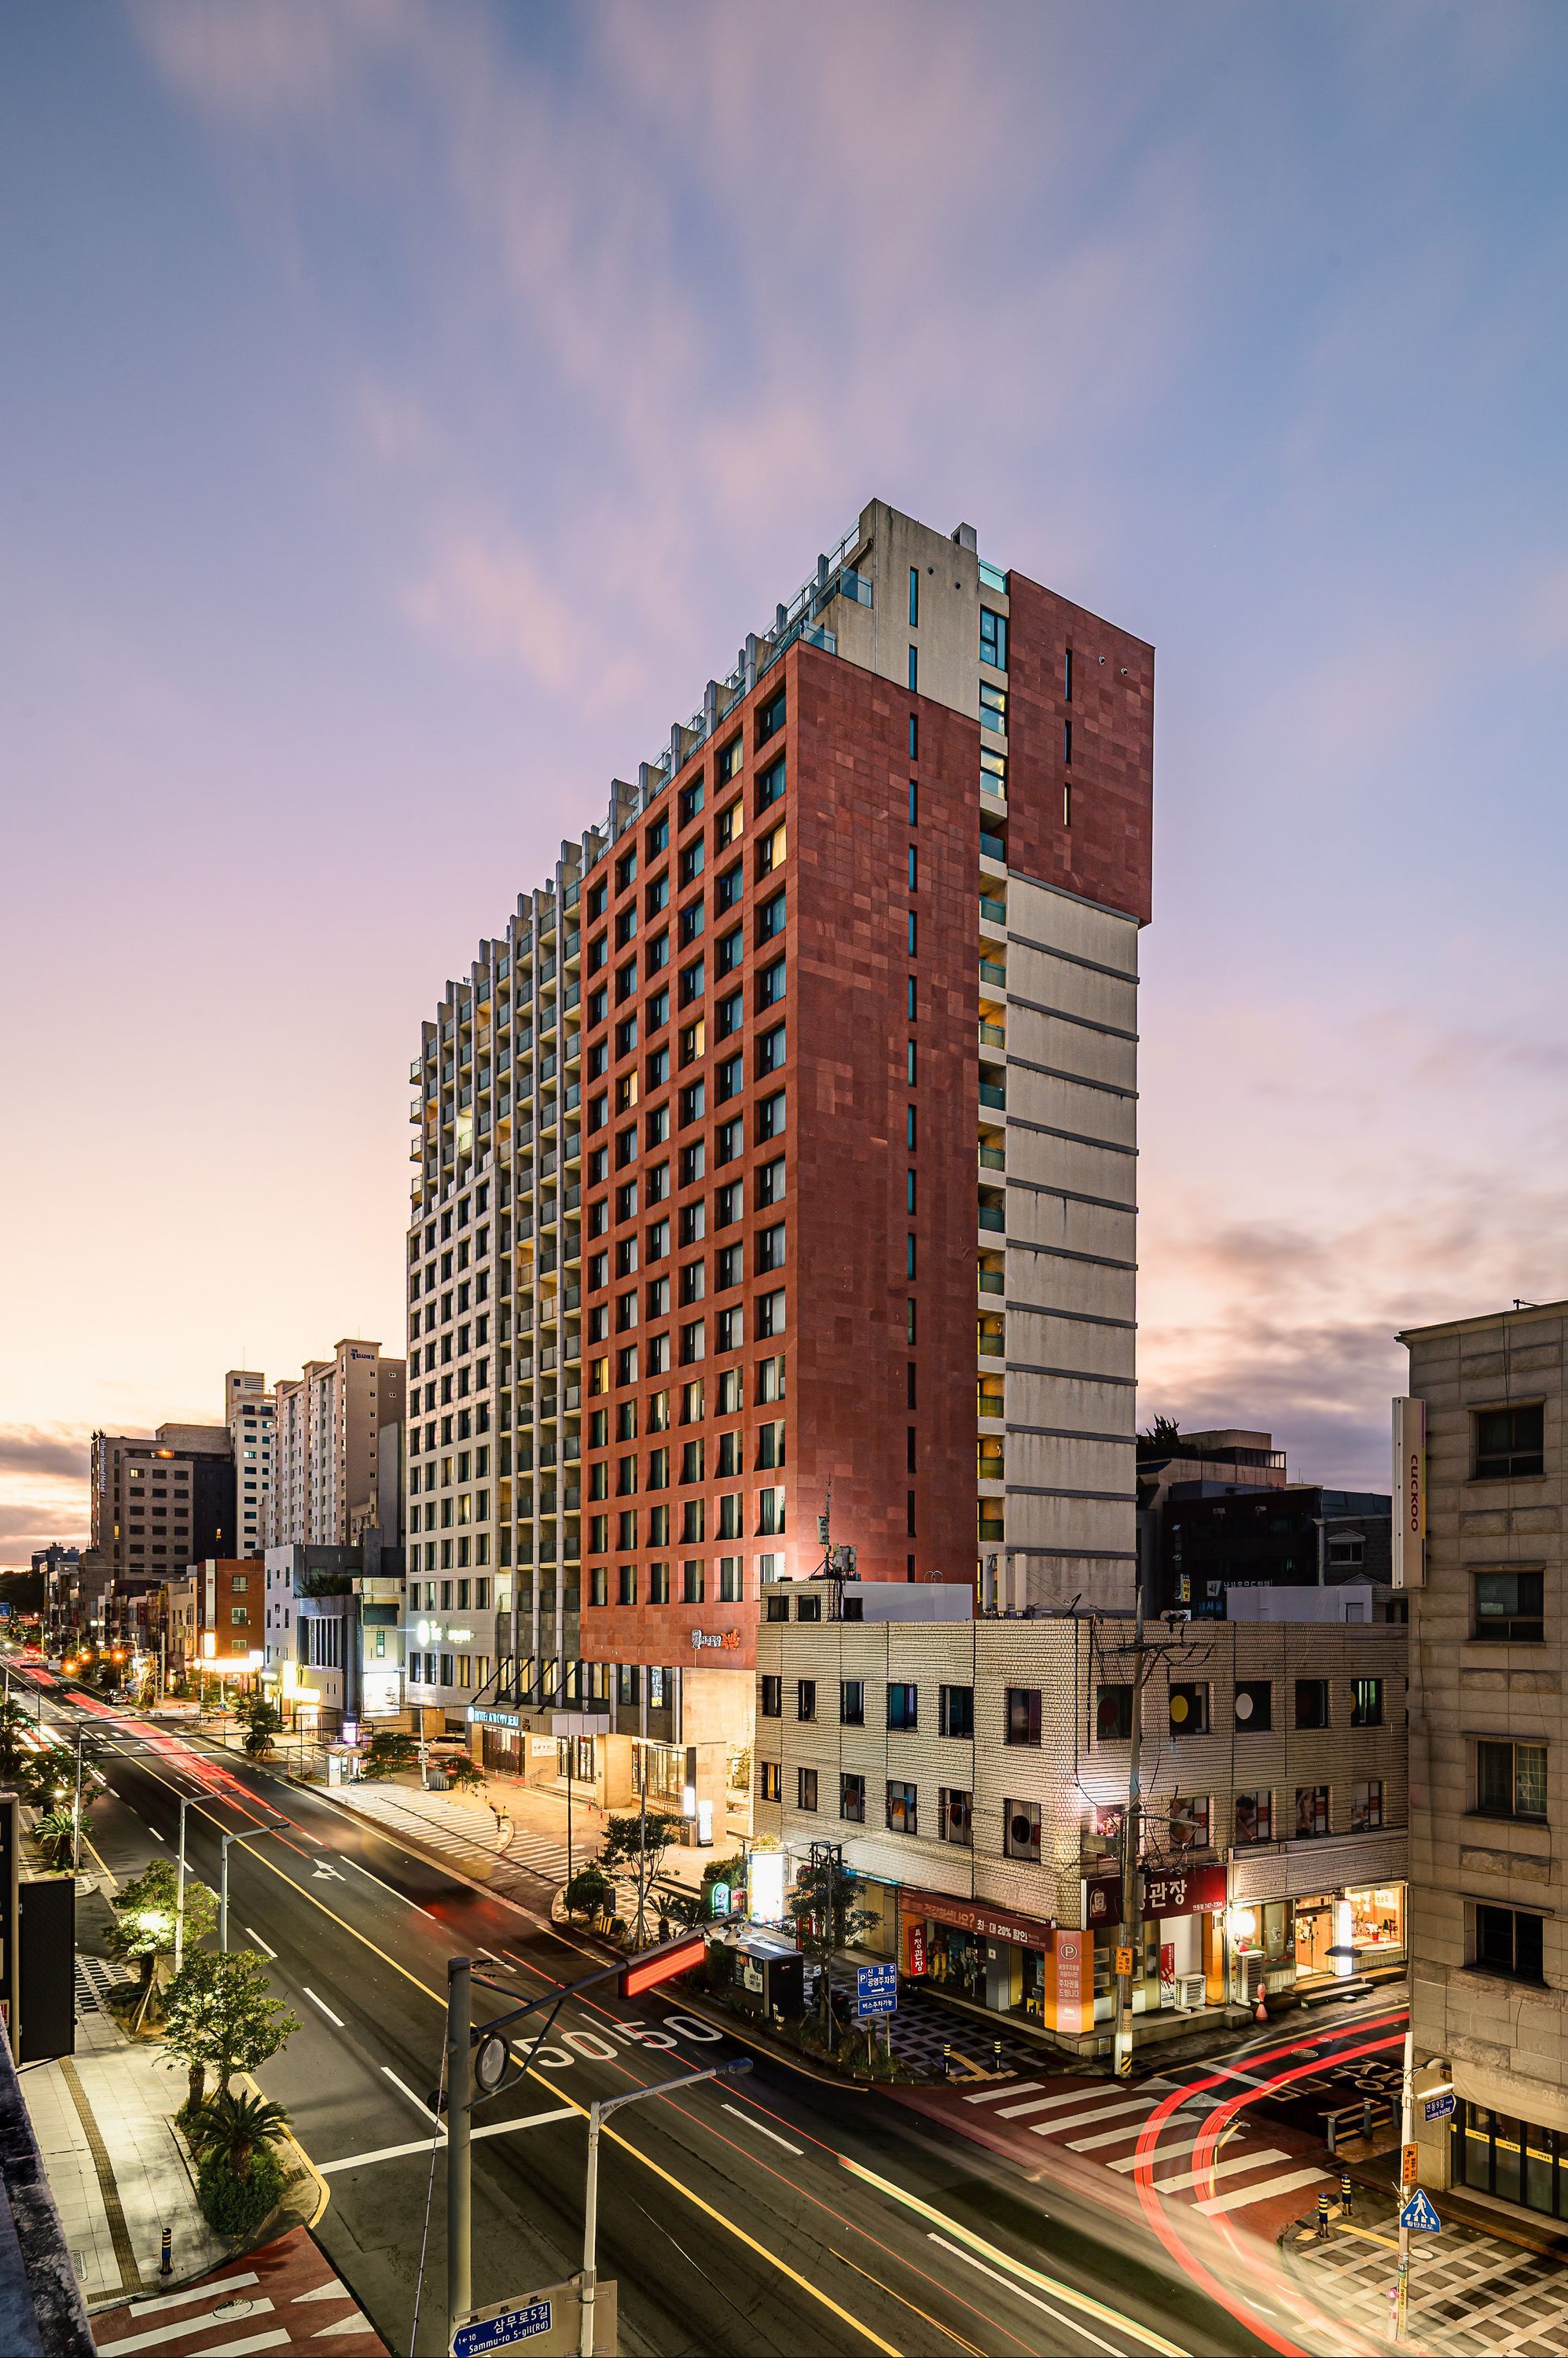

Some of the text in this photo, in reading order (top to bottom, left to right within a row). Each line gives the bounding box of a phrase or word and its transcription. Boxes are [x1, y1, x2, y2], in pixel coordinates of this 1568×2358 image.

[997, 1925, 1012, 1937] 20%
[1012, 1929, 1028, 1942] 할인
[913, 1937, 924, 1971] 정관장
[868, 1974, 895, 1987] 공영주차장
[1059, 1979, 1079, 1989] 주차권을
[1059, 1989, 1079, 1998] 드립니다
[862, 2000, 893, 2009] 버스주차가능
[612, 2016, 723, 2049] 50
[512, 2031, 619, 2067] 50
[1426, 2099, 1445, 2113] 연동9길
[1407, 2220, 1434, 2230] 횡단보도
[494, 2305, 548, 2334] 삼무로5길
[468, 2319, 549, 2354] Sammu-ro 5-gil(Rd)
